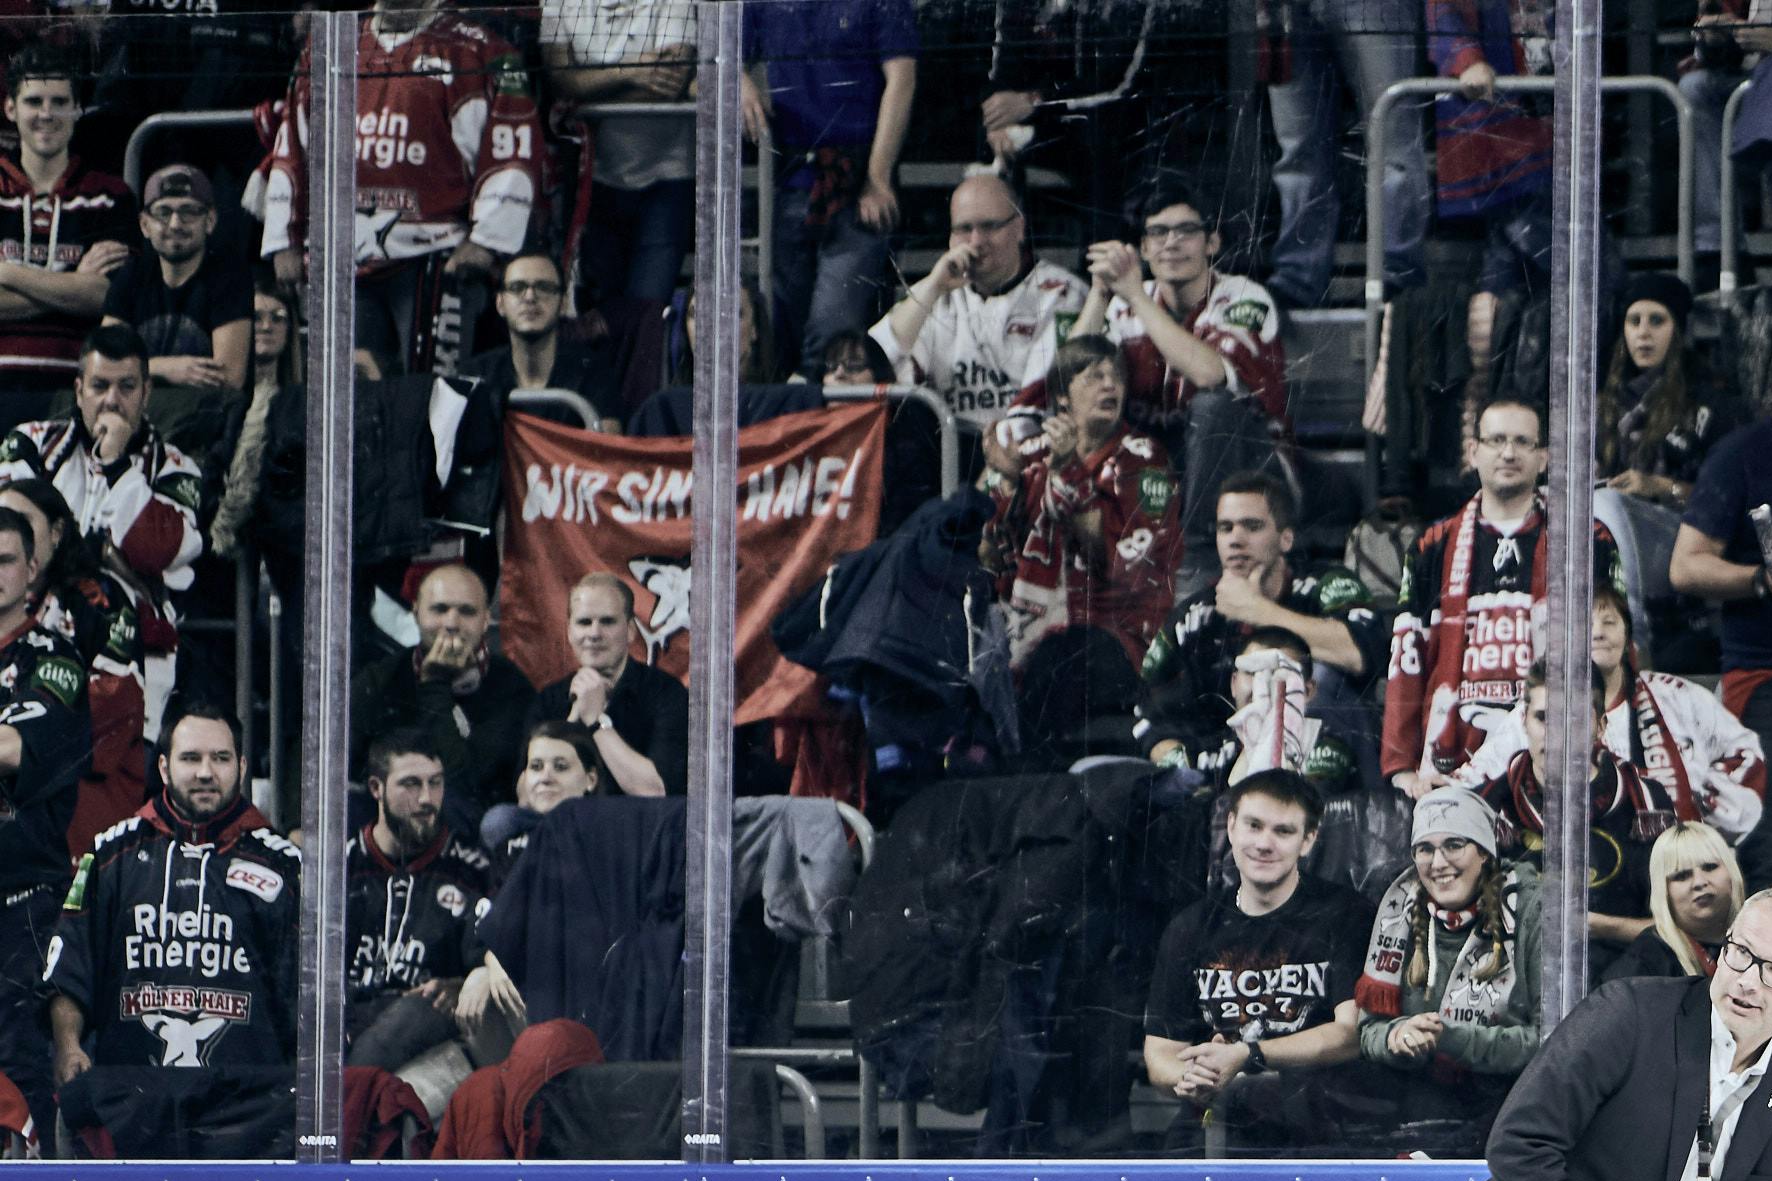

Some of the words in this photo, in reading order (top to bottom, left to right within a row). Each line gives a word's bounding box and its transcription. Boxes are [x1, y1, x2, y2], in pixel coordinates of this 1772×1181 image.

[492, 124, 532, 160] 91
[522, 463, 608, 526] WIR
[611, 465, 693, 523] SIN
[135, 904, 233, 941] Rhein
[126, 935, 250, 978] Energie
[123, 986, 195, 1016] KÖLNER
[201, 992, 248, 1018] HAIE
[1454, 1008, 1488, 1026] 110%
[307, 1135, 337, 1146] RAITA
[692, 1133, 721, 1145] RAITA
